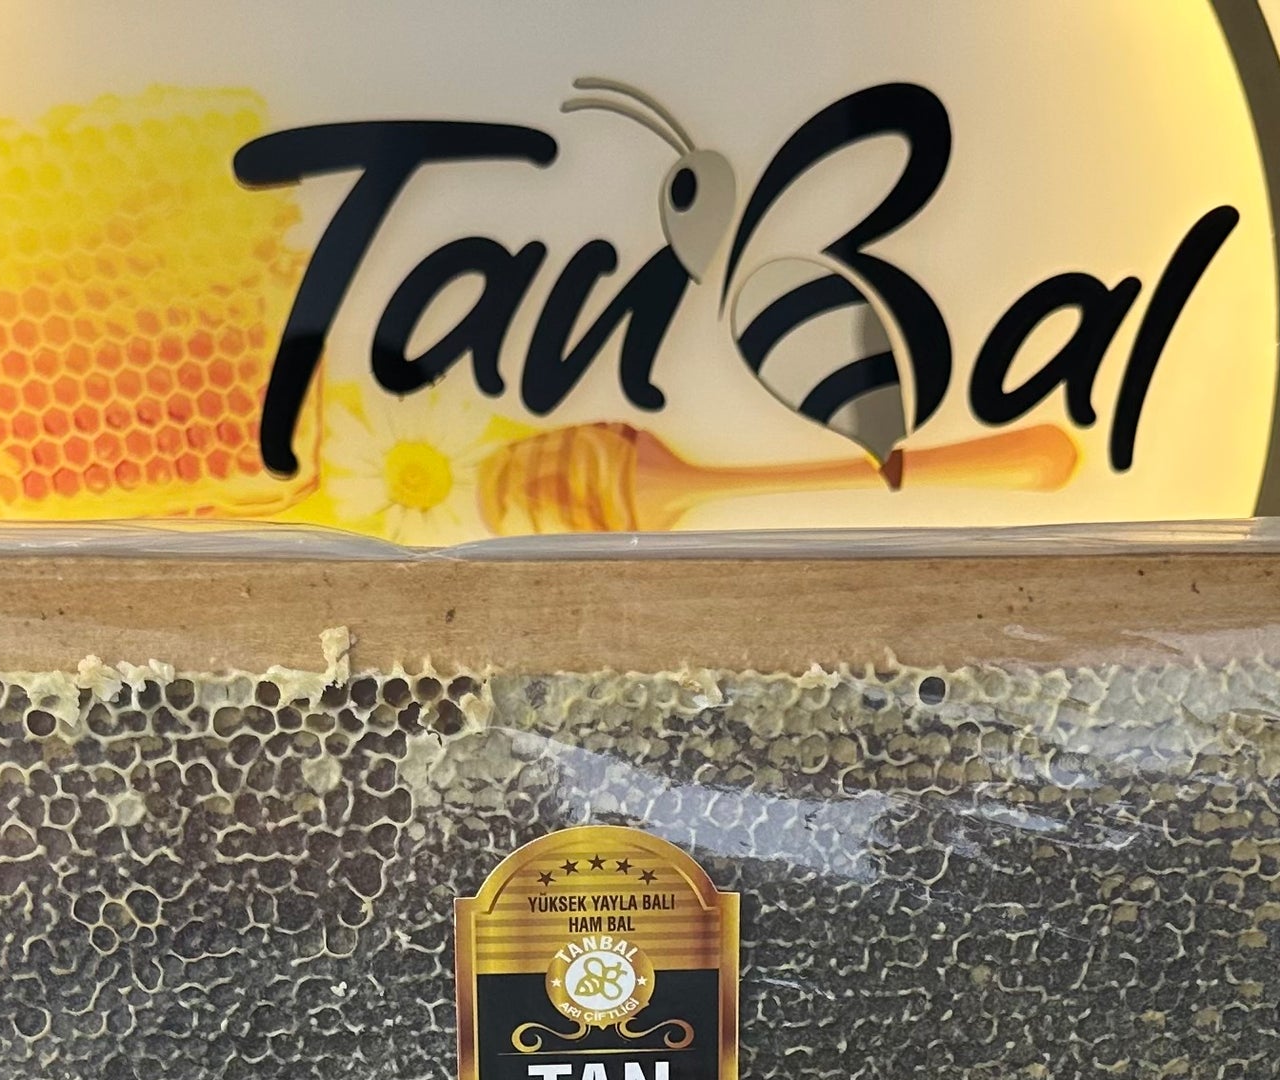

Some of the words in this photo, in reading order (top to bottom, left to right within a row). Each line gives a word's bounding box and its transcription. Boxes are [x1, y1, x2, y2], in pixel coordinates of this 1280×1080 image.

[527, 892, 586, 913] YÜKSEK
[590, 895, 638, 912] YAYLA
[642, 893, 675, 911] BALI
[568, 916, 603, 933] HAM
[607, 915, 635, 932] BAL
[554, 935, 639, 964] TANBAL
[559, 1001, 580, 1020] ARI
[583, 997, 640, 1023] ÇİFTLİĞİ
